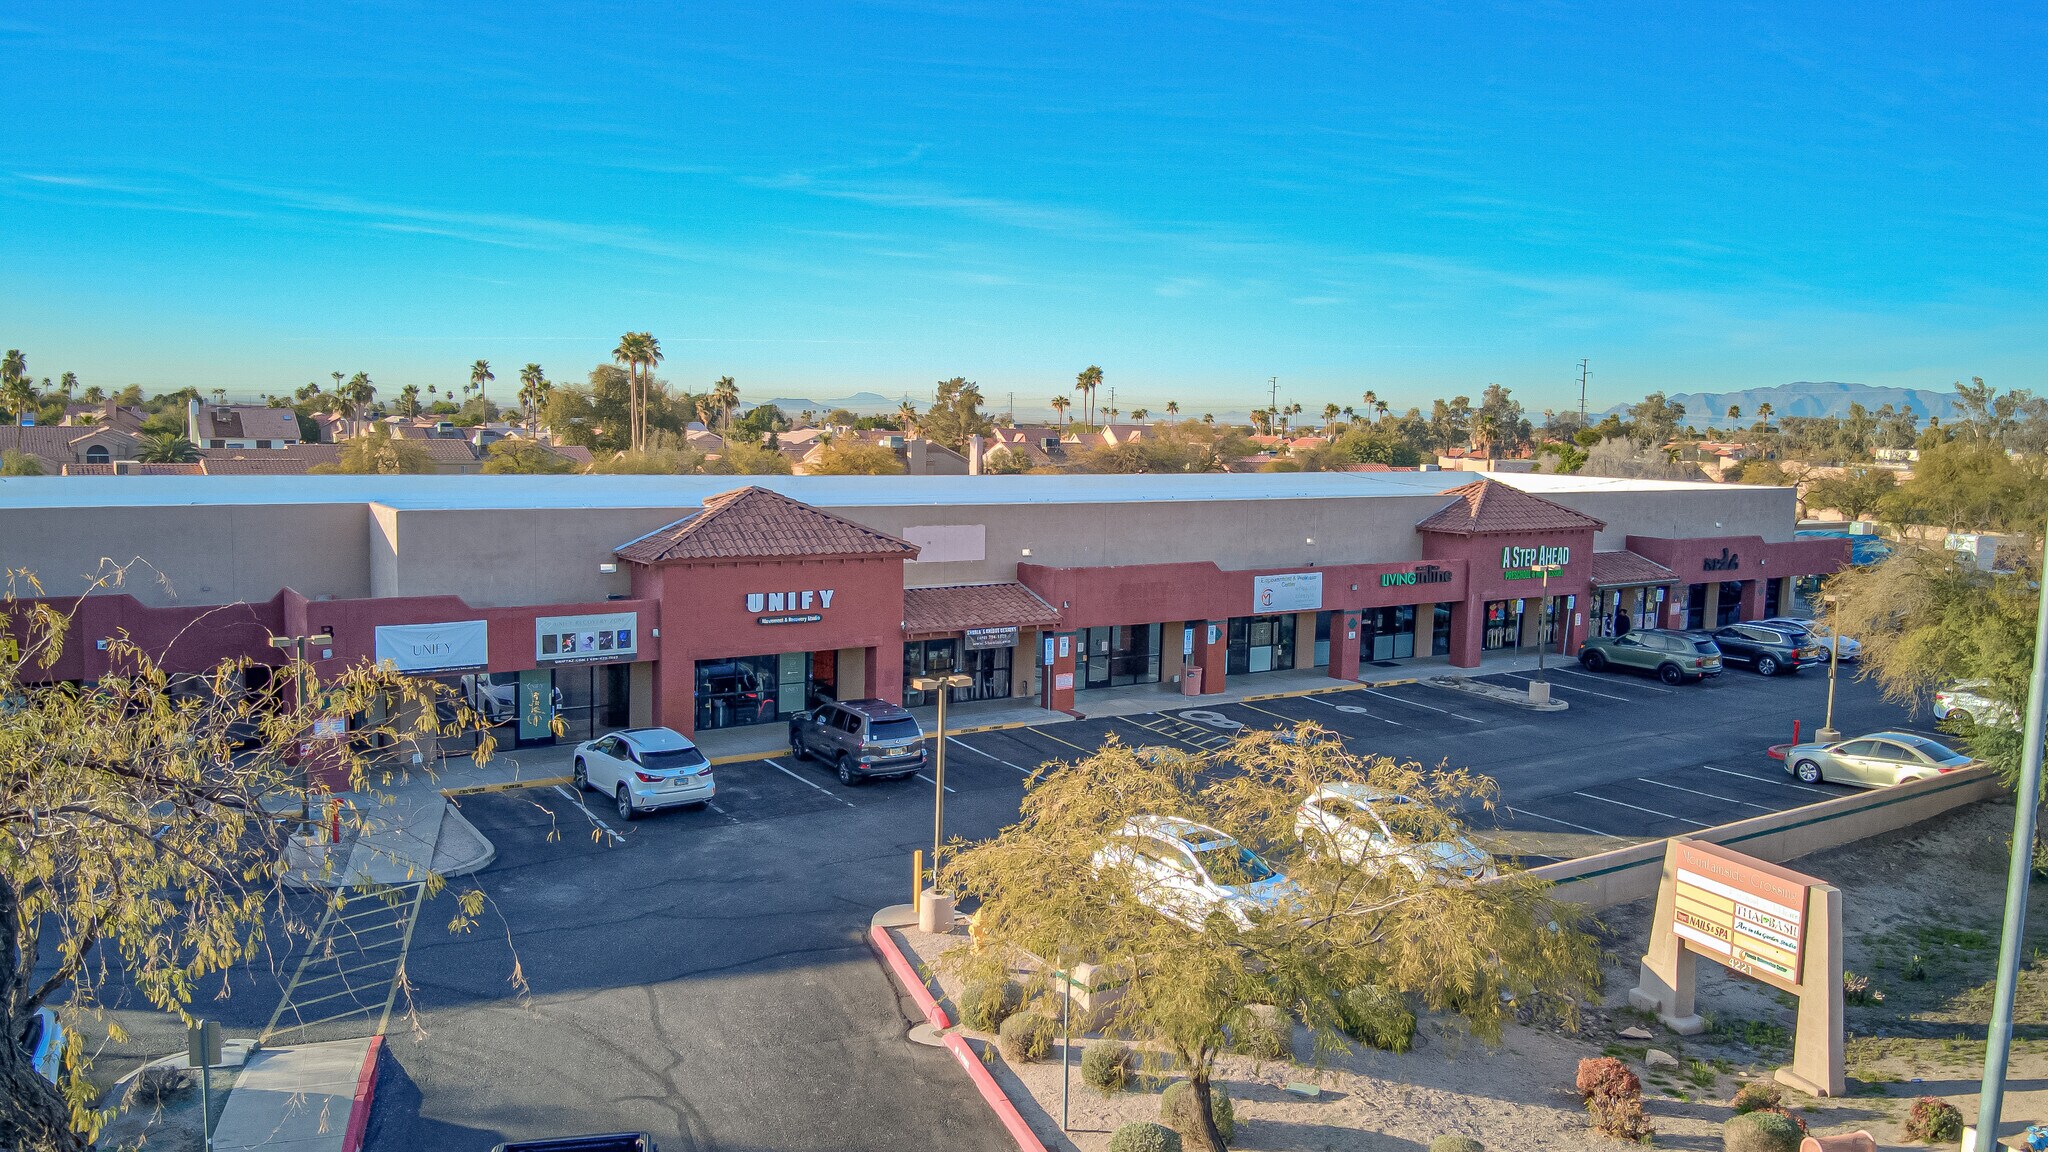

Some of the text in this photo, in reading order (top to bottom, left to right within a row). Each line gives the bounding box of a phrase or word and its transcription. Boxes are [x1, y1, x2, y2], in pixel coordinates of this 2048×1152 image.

[1502, 546, 1511, 569] A
[1381, 572, 1417, 587] LIVING
[745, 589, 835, 613] UNIFY
[412, 643, 453, 656] UNIFY
[1682, 849, 1745, 883] Mountainside
[1750, 873, 1798, 905] Crossing
[1690, 916, 1711, 932] NAILS
[1714, 926, 1728, 940] SPA
[1762, 933, 1779, 943] Garden
[1728, 958, 1752, 976] 4221
